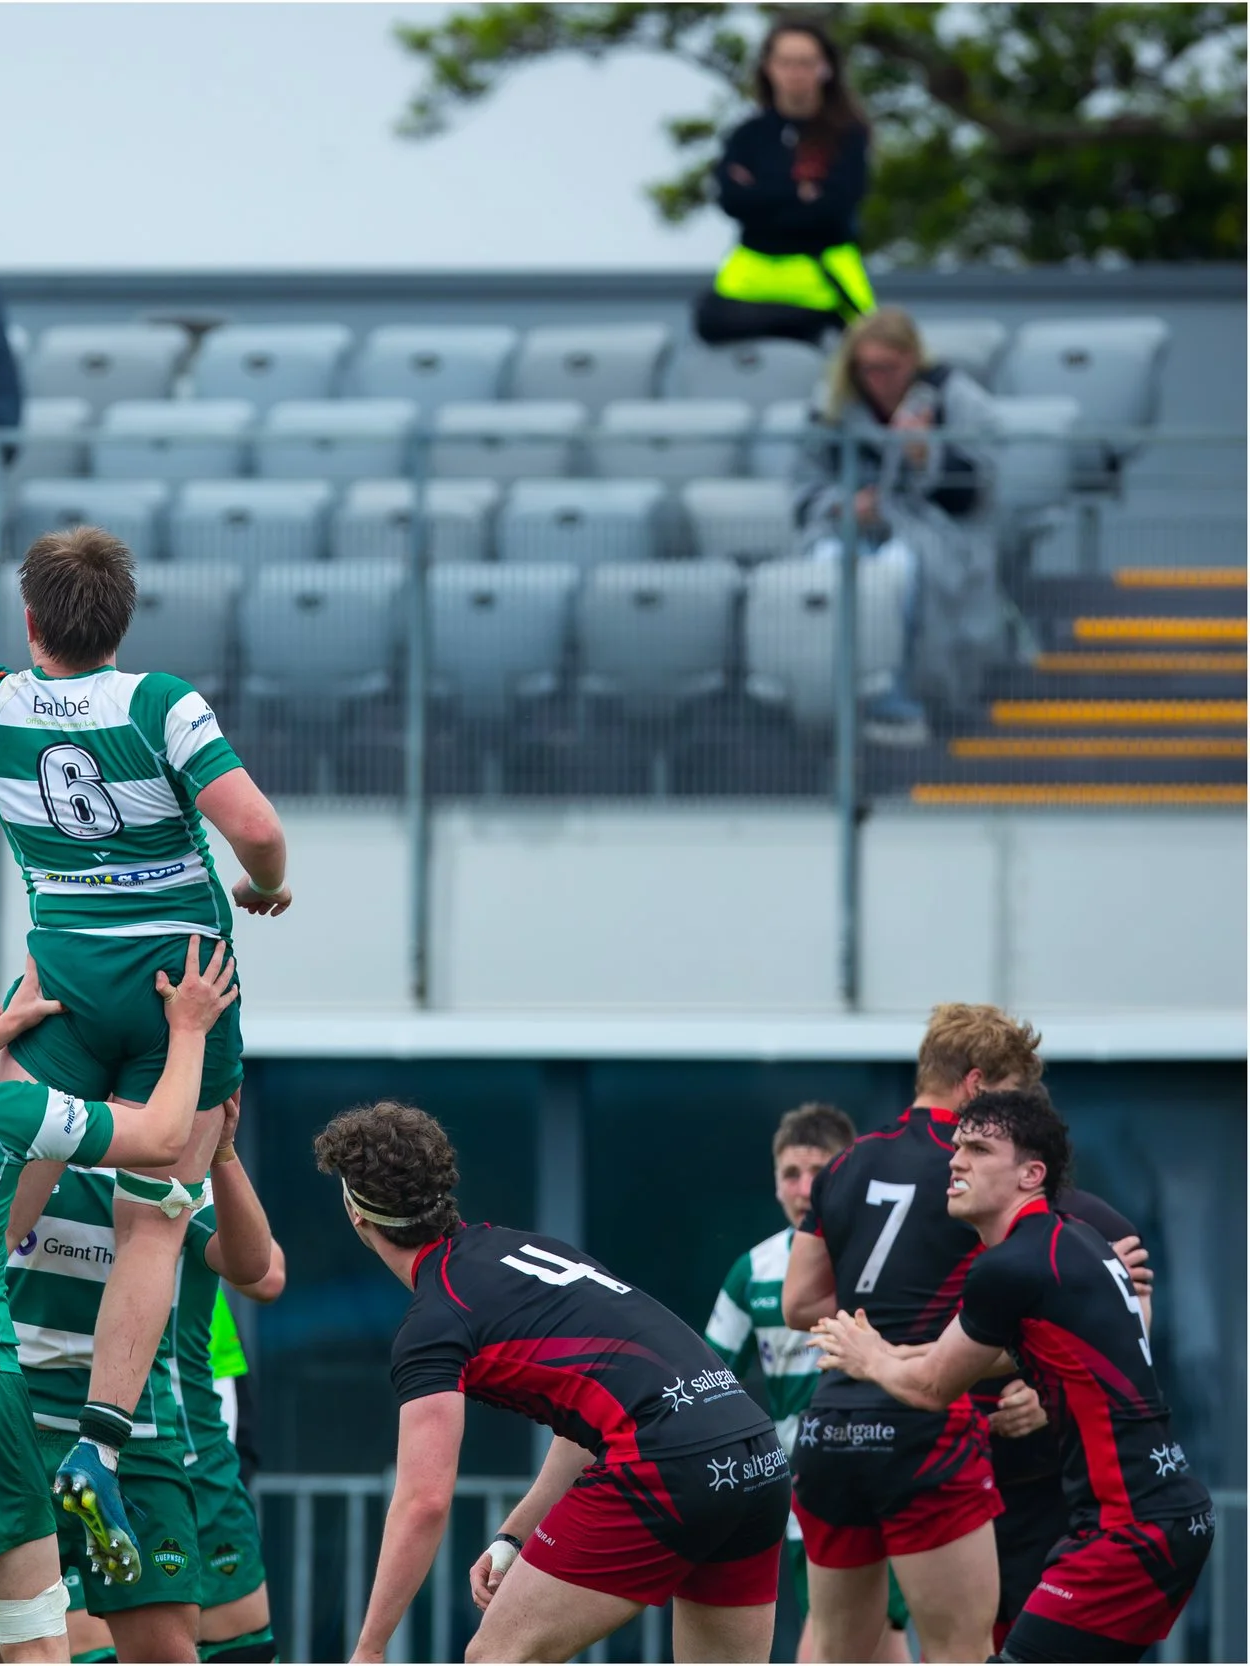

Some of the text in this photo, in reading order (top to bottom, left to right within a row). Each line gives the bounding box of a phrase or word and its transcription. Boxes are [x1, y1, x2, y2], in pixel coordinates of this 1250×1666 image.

[33, 695, 90, 717] Babbé
[36, 741, 124, 840] 6
[43, 1237, 115, 1264] Grant Th
[854, 1179, 917, 1293] 7
[500, 1244, 632, 1295] 4
[822, 1422, 895, 1446] satgate
